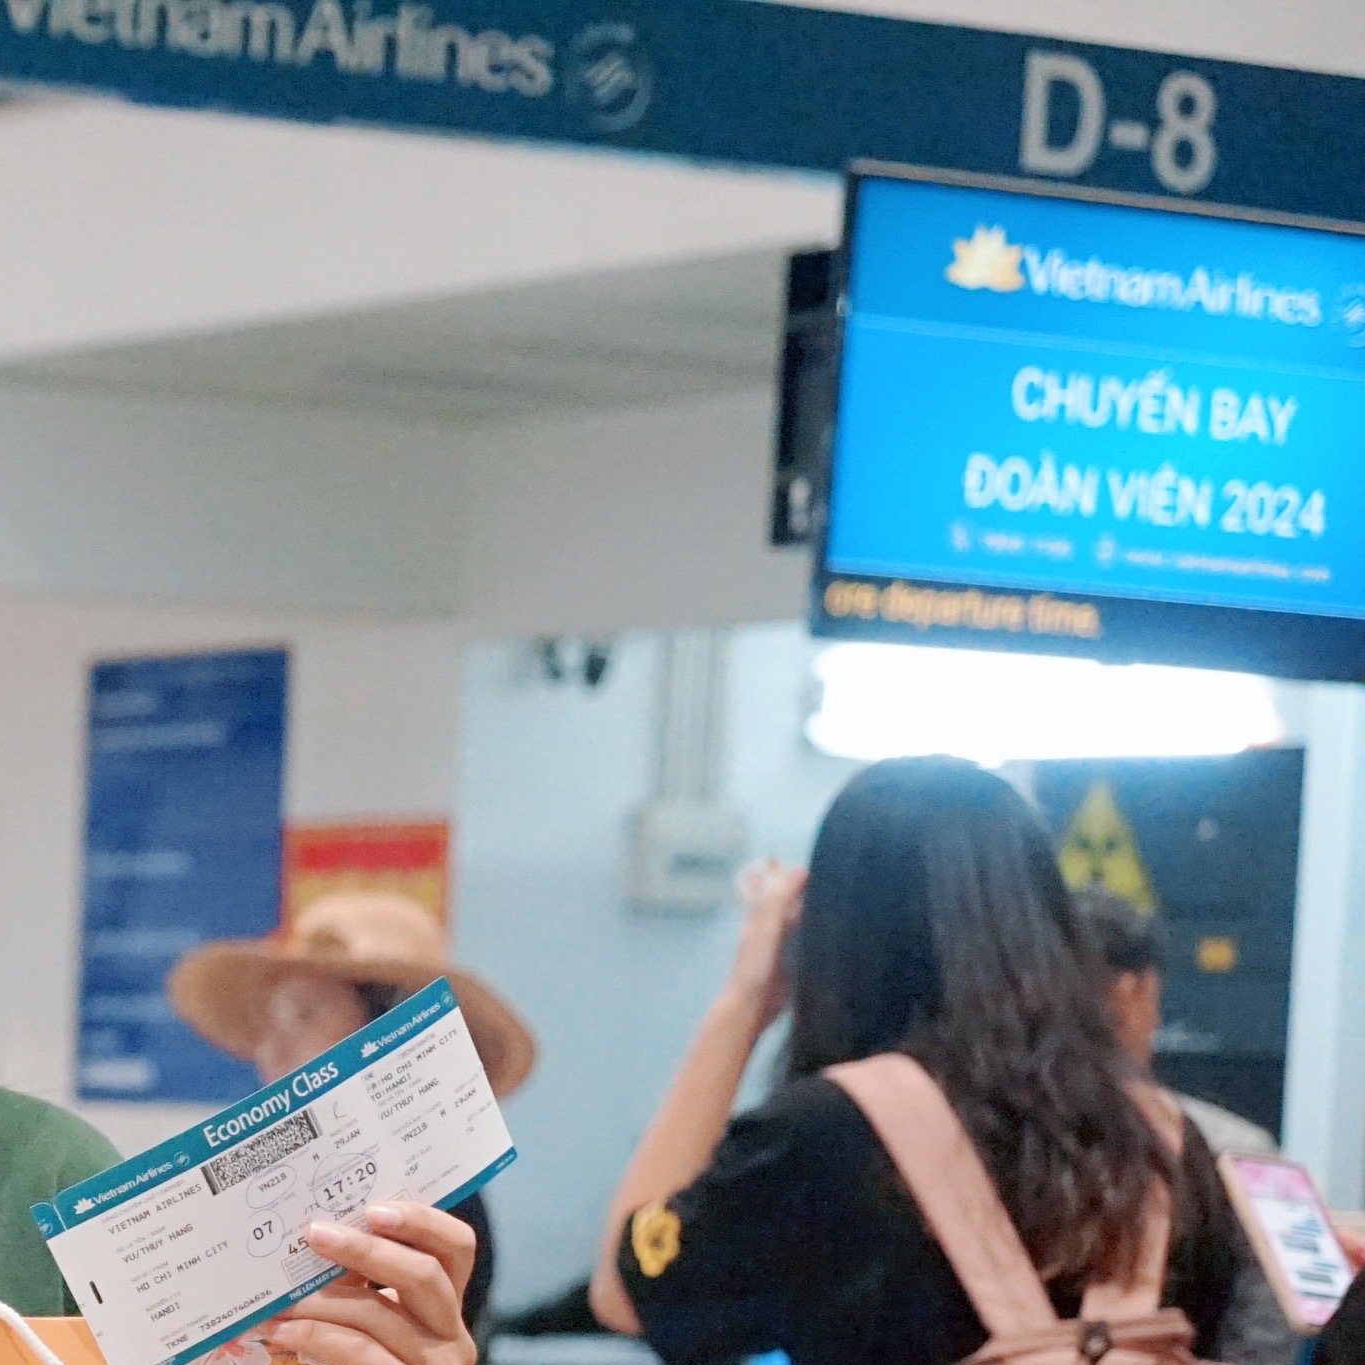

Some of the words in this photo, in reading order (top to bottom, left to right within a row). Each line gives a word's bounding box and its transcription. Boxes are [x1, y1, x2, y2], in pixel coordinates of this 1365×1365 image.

[1020, 50, 1218, 193] D-8
[1209, 386, 1298, 445] BAY
[1107, 465, 1212, 528] VIÊN
[1221, 480, 1327, 540] 2024
[202, 1087, 292, 1148] Economy
[290, 1061, 339, 1097] Class
[418, 1078, 440, 1096] HANG
[401, 1122, 428, 1143] VN218
[258, 1172, 287, 1192] VN218
[334, 1128, 361, 1149] 29JAN
[323, 1161, 377, 1202] 17:20
[108, 1209, 151, 1235] VIETNAM
[156, 1183, 202, 1212] AIRLINES
[122, 1240, 164, 1264] VU/THUY
[168, 1223, 193, 1241] HANG
[253, 1220, 273, 1241] 07
[154, 1271, 173, 1285] CHI
[177, 1258, 201, 1273] MINH
[204, 1241, 230, 1258] CITY
[150, 1302, 181, 1322] HANOI
[165, 1334, 189, 1350] TKNE
